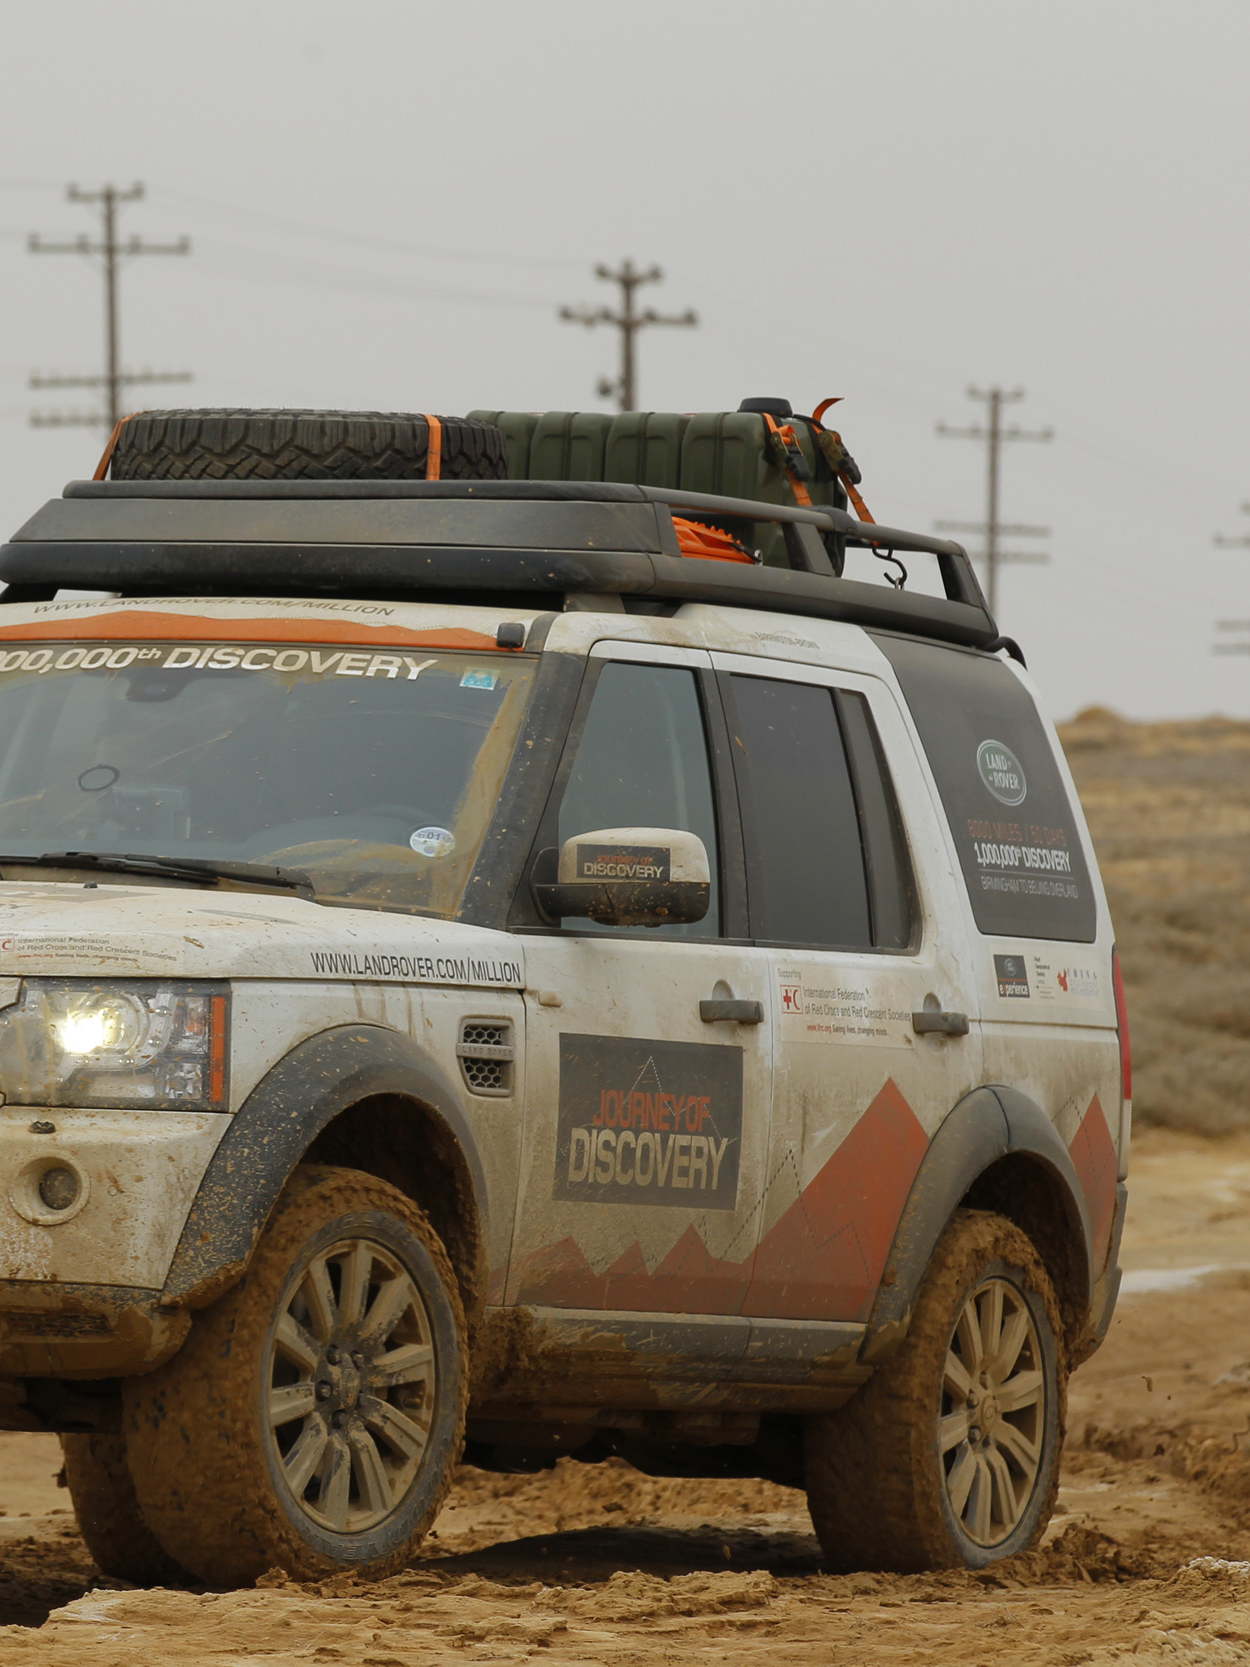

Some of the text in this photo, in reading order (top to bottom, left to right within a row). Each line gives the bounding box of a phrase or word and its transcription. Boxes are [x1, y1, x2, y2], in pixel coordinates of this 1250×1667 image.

[162, 647, 438, 680] DISCOVERY
[985, 753, 1007, 771] LAND
[993, 772, 1020, 790] ROVER
[993, 821, 1022, 842] MILES
[1045, 826, 1067, 848] DAYS
[1022, 846, 1071, 872] DISCOVERY
[584, 862, 664, 878] DISCOVERY
[981, 876, 1078, 899] BIRMINGHAM TO BEIJING OVERLAND
[18, 936, 110, 945] International Federation
[105, 946, 141, 956] Crescent
[142, 949, 177, 962] Societies
[310, 952, 522, 983] WWW.LANDROVER.COM/MILLION
[777, 968, 801, 980] Supporting
[803, 986, 866, 1000] International Federation
[811, 1004, 823, 1015] Red
[840, 1006, 850, 1017] and
[851, 1006, 863, 1018] Red
[863, 1007, 887, 1020] Crescent
[888, 1009, 911, 1022] Societies
[832, 1024, 846, 1035] Saving
[857, 1027, 874, 1037] changing
[593, 1089, 711, 1132] JOURNEY OF
[567, 1128, 728, 1190] DISCOVERY
